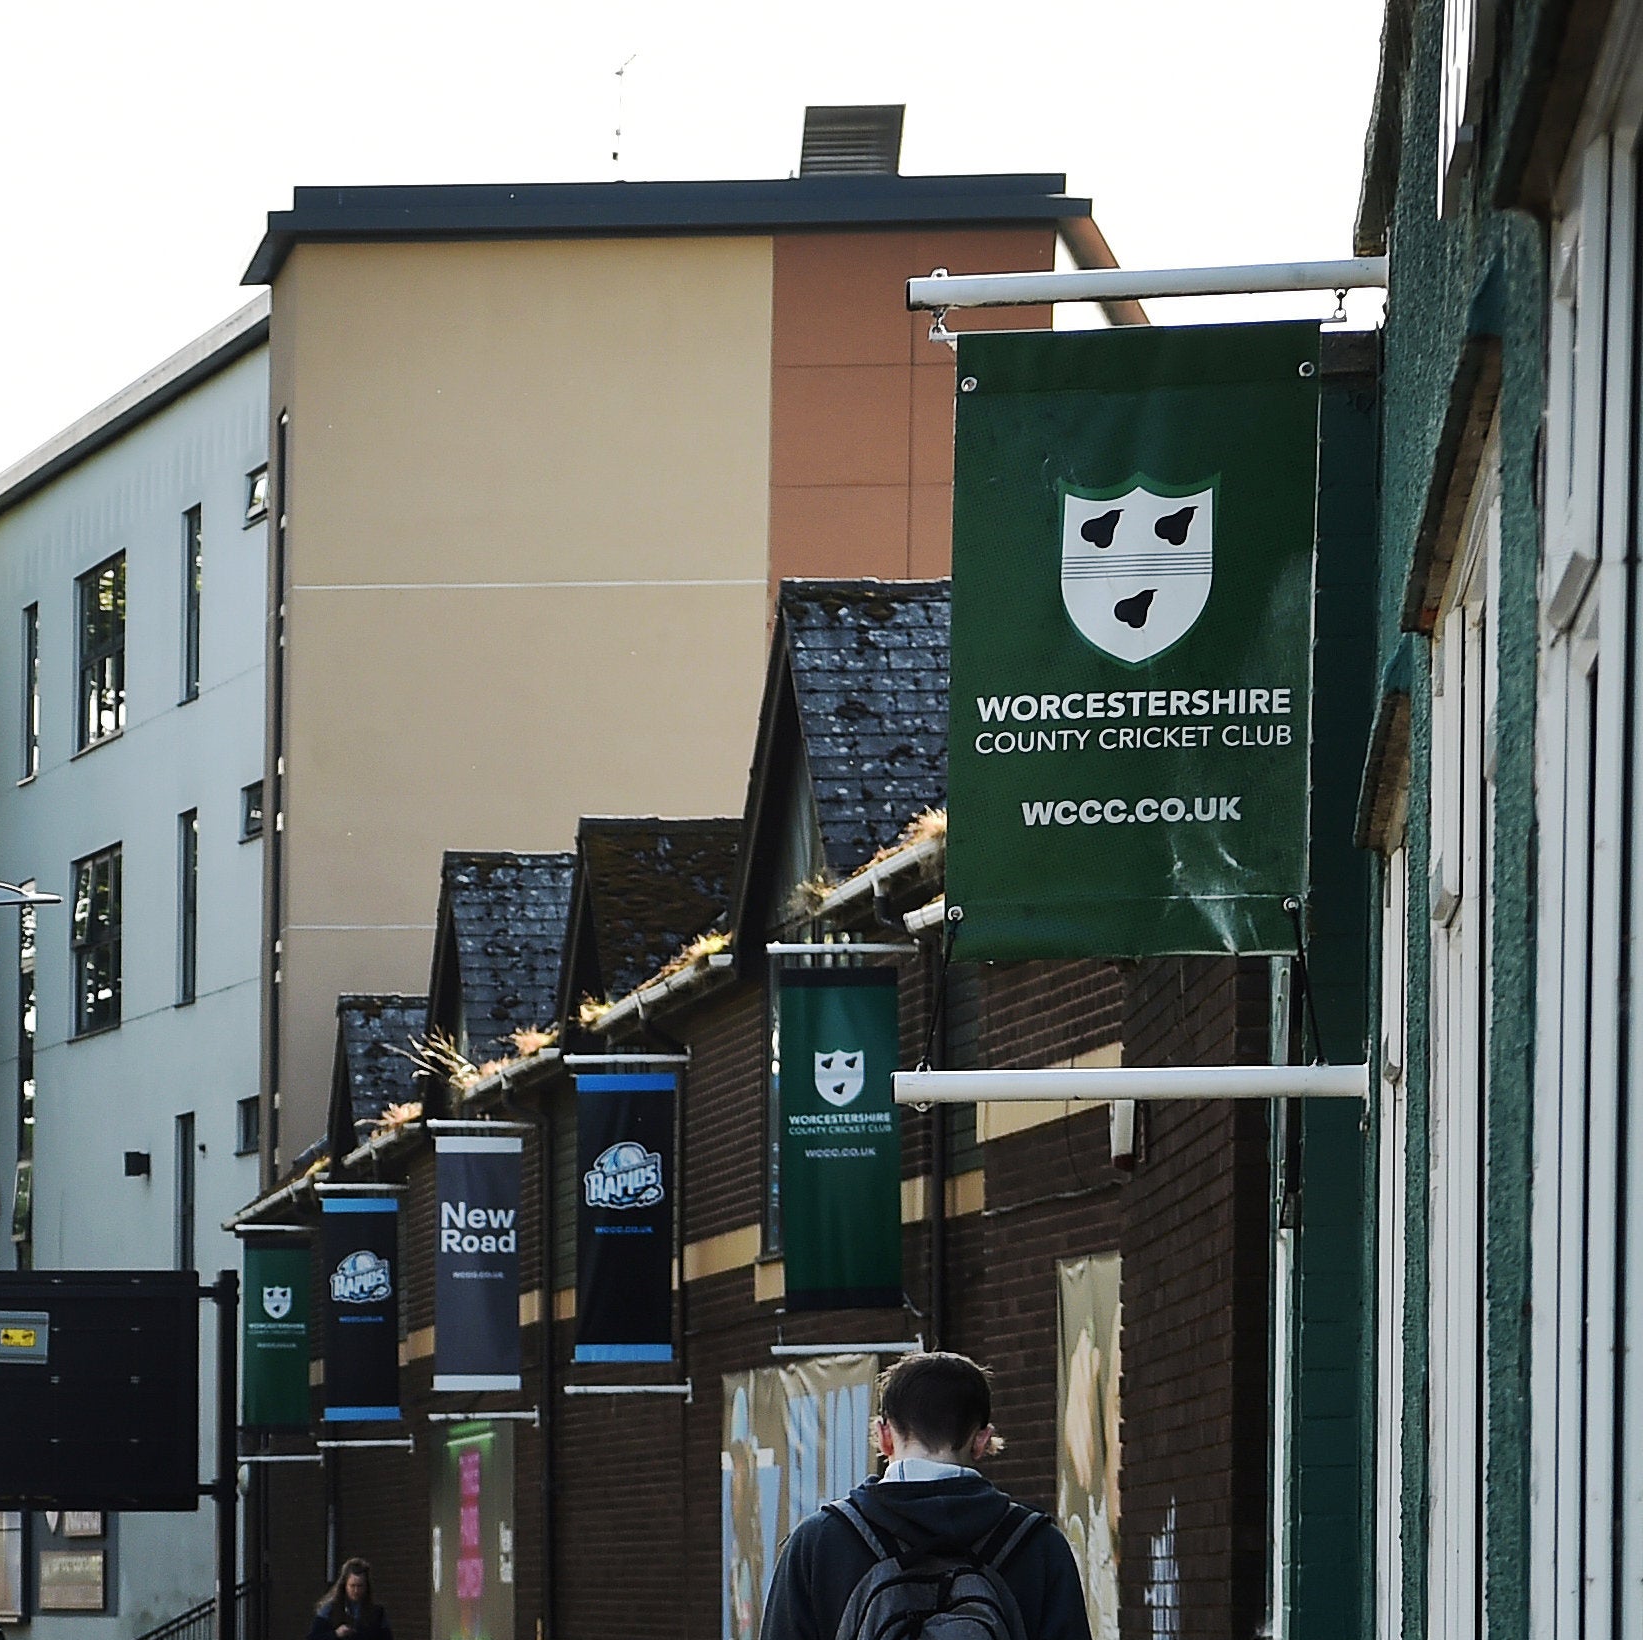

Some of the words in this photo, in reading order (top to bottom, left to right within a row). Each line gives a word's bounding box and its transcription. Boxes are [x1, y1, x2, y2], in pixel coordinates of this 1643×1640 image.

[976, 688, 1292, 723] WORCESTERSHIRE
[974, 729, 1092, 755] COUNTY
[1098, 725, 1214, 750] CRICKET
[1221, 725, 1292, 747] CLUB
[1021, 796, 1242, 827] WCCC.CO.UK
[788, 1112, 892, 1125] WORCESTERSHIRE
[788, 1126, 826, 1136] COUNTY
[867, 1124, 892, 1133] CLUB
[440, 1201, 515, 1229] New
[440, 1229, 516, 1253] Road
